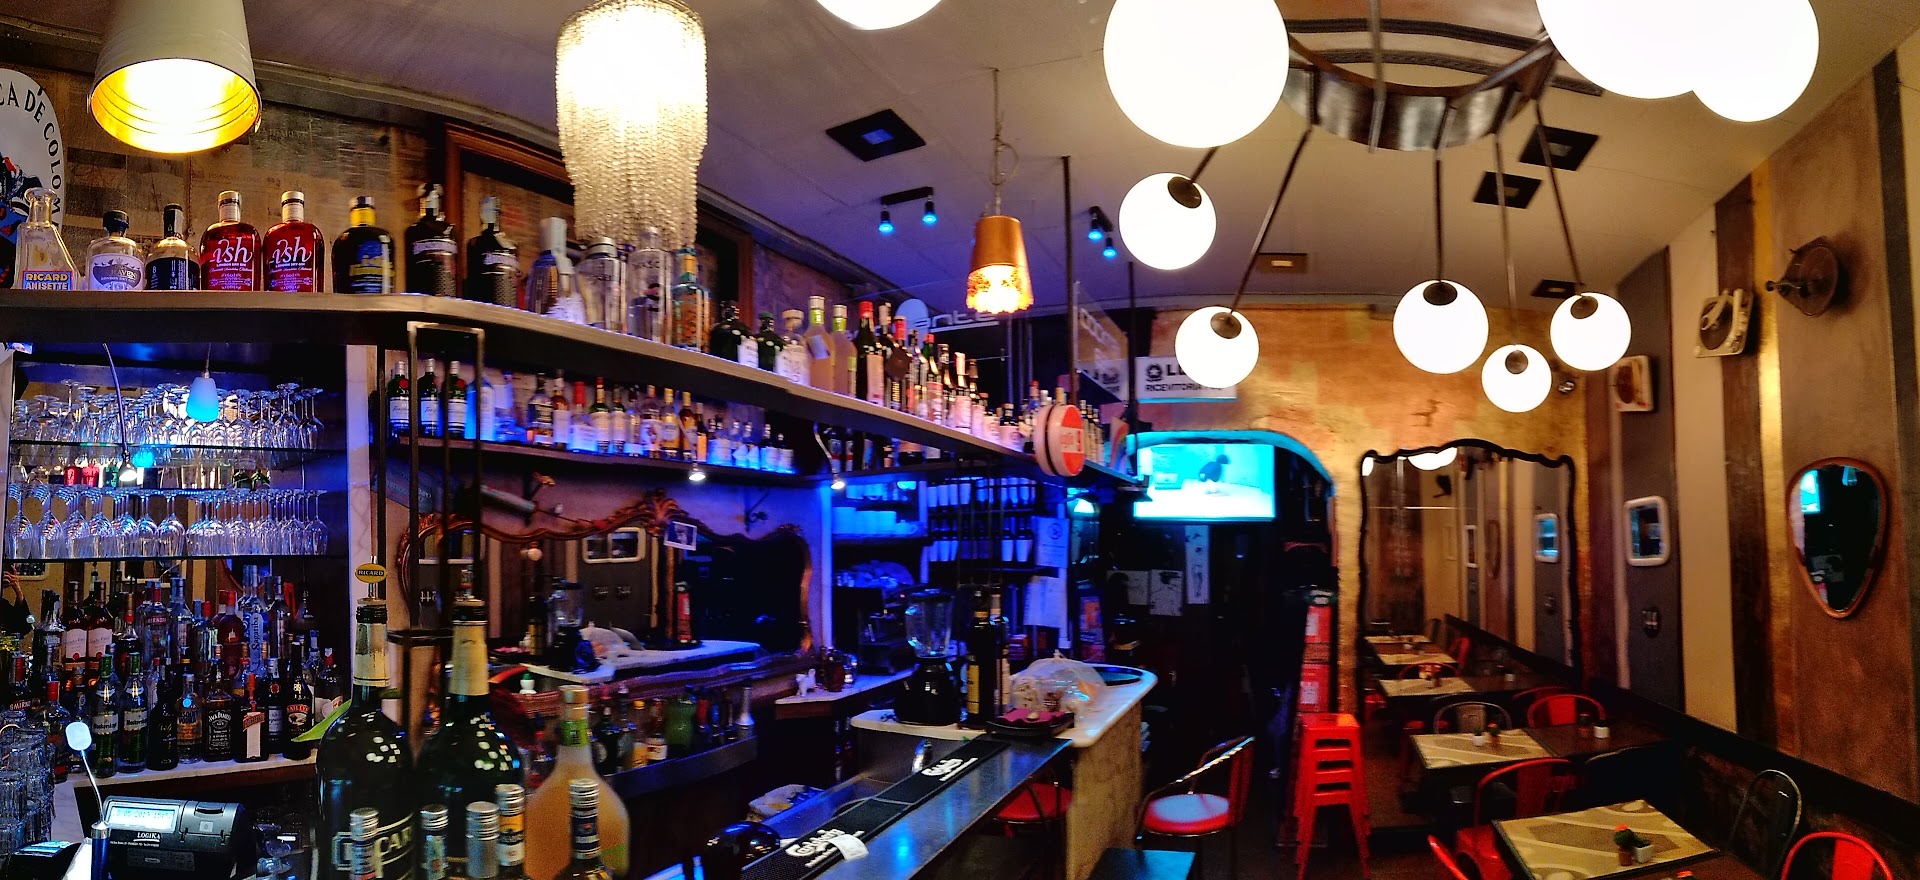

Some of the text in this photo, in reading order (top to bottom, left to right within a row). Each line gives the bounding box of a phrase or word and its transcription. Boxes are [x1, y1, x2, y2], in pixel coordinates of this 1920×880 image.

[25, 88, 46, 123] DE
[43, 121, 62, 228] COLOM
[210, 236, 253, 263] ish
[269, 236, 312, 263] ish
[26, 273, 69, 281] RICARD
[26, 281, 68, 290] ANISETTE
